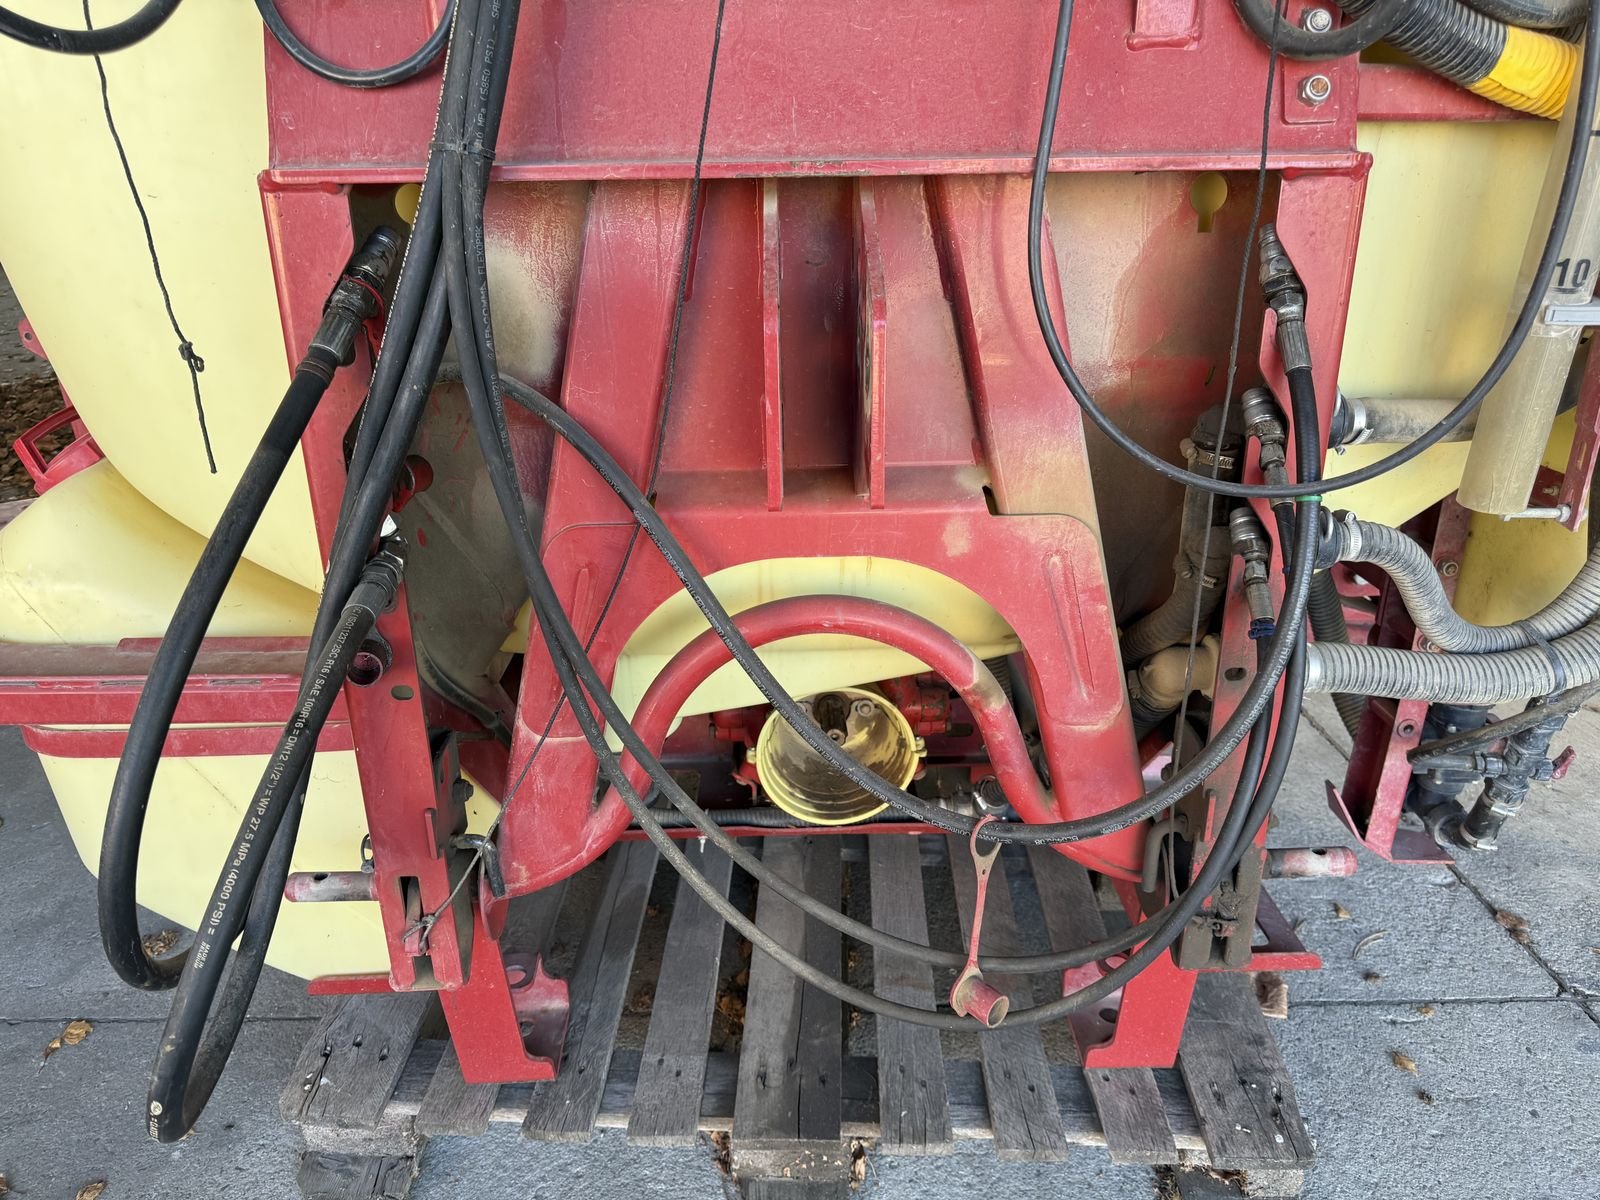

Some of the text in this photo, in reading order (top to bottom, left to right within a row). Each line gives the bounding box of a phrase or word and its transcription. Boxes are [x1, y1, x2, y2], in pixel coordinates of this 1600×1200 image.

[484, 38, 495, 63] PSI)
[479, 68, 490, 100] (5850
[477, 107, 486, 126] MPa
[475, 225, 485, 274] FLEXOPAK
[1556, 258, 1591, 288] 10
[336, 614, 357, 644] ISO11237
[328, 642, 342, 659] 2SC
[1277, 646, 1290, 665] R17
[320, 657, 334, 674] R16
[309, 677, 325, 697] SAE
[294, 695, 315, 729] 100R16
[278, 734, 297, 762] DN12
[266, 761, 285, 788] (1/2")
[254, 795, 270, 816] WP
[243, 815, 261, 841] 27.5
[232, 841, 250, 867] MPa
[219, 867, 239, 900] (4000
[208, 901, 226, 926] PSI)
[193, 941, 206, 968] BELGIUM
[202, 944, 211, 962] MADE
